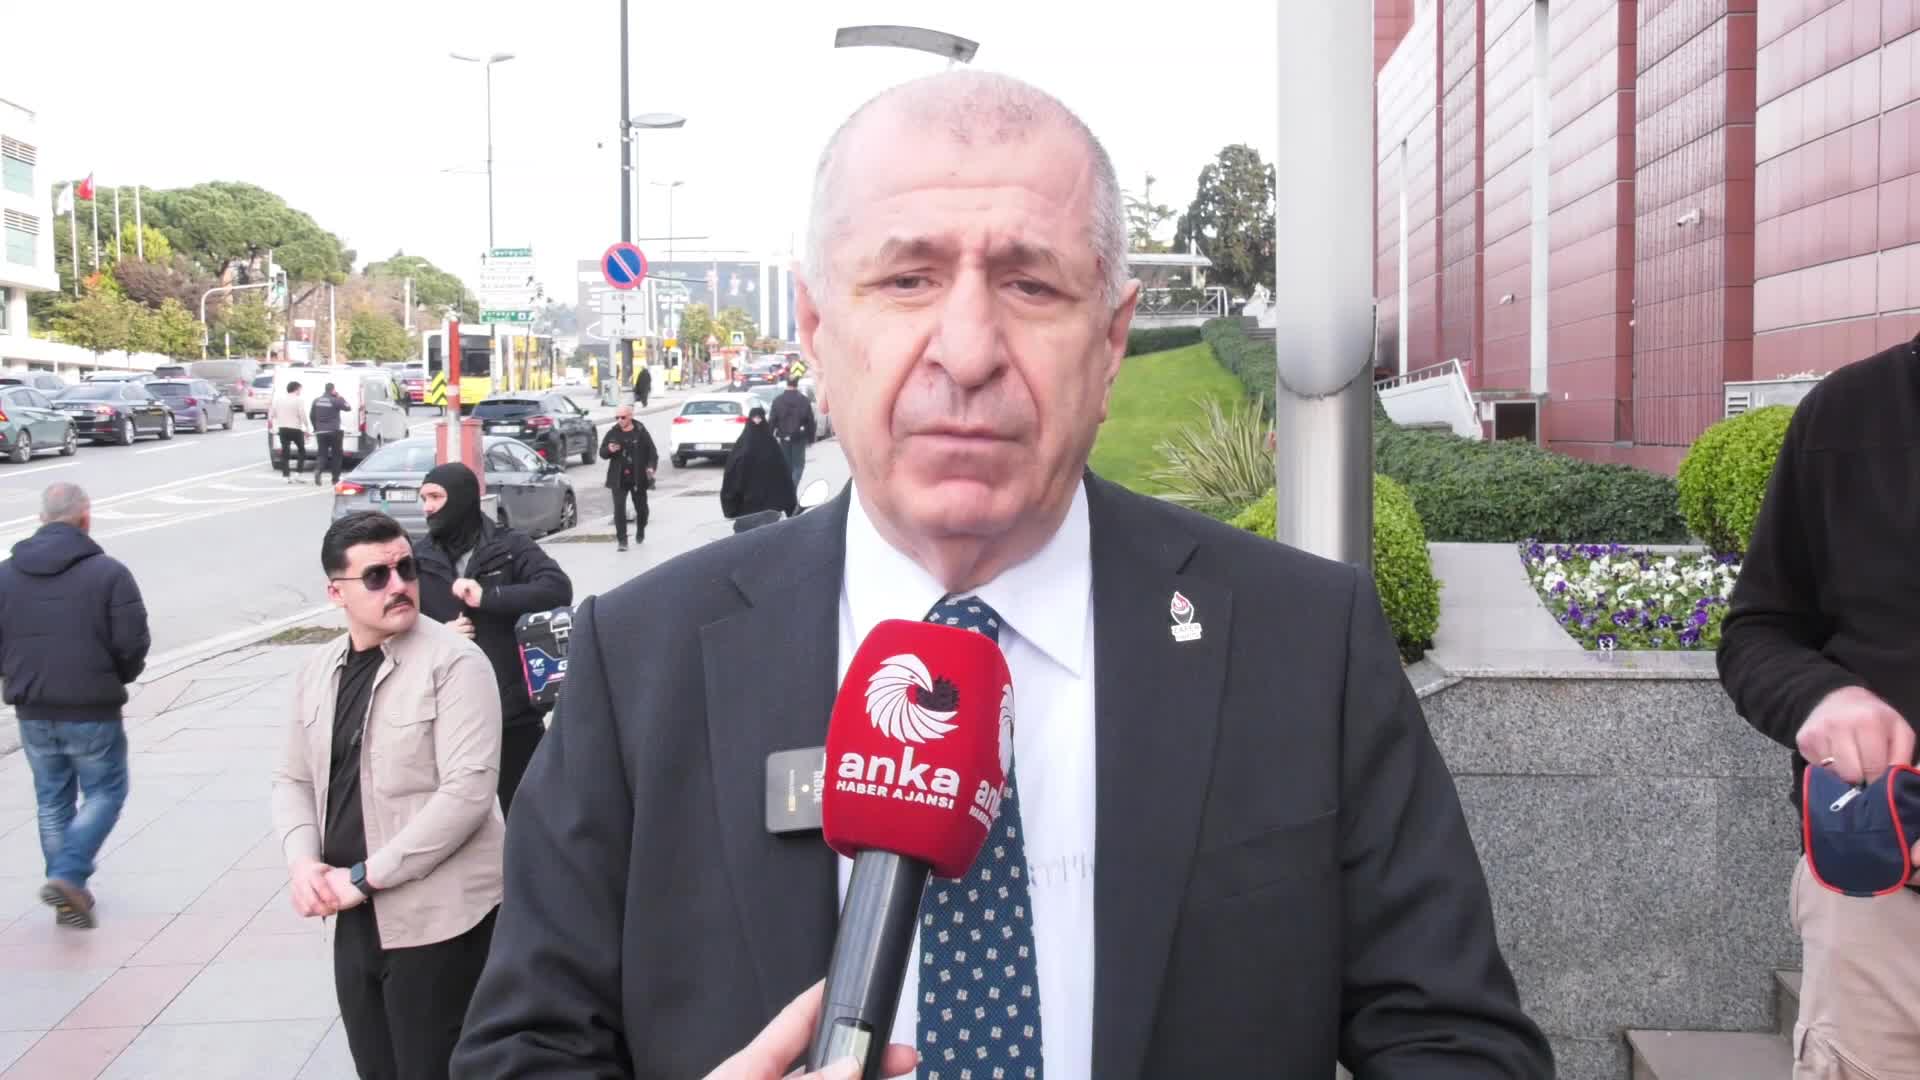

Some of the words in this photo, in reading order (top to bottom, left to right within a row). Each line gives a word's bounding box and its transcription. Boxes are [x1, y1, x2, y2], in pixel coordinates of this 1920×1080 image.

[837, 746, 960, 795] anka
[836, 780, 887, 798] HABER
[891, 788, 955, 809] AJANSI
